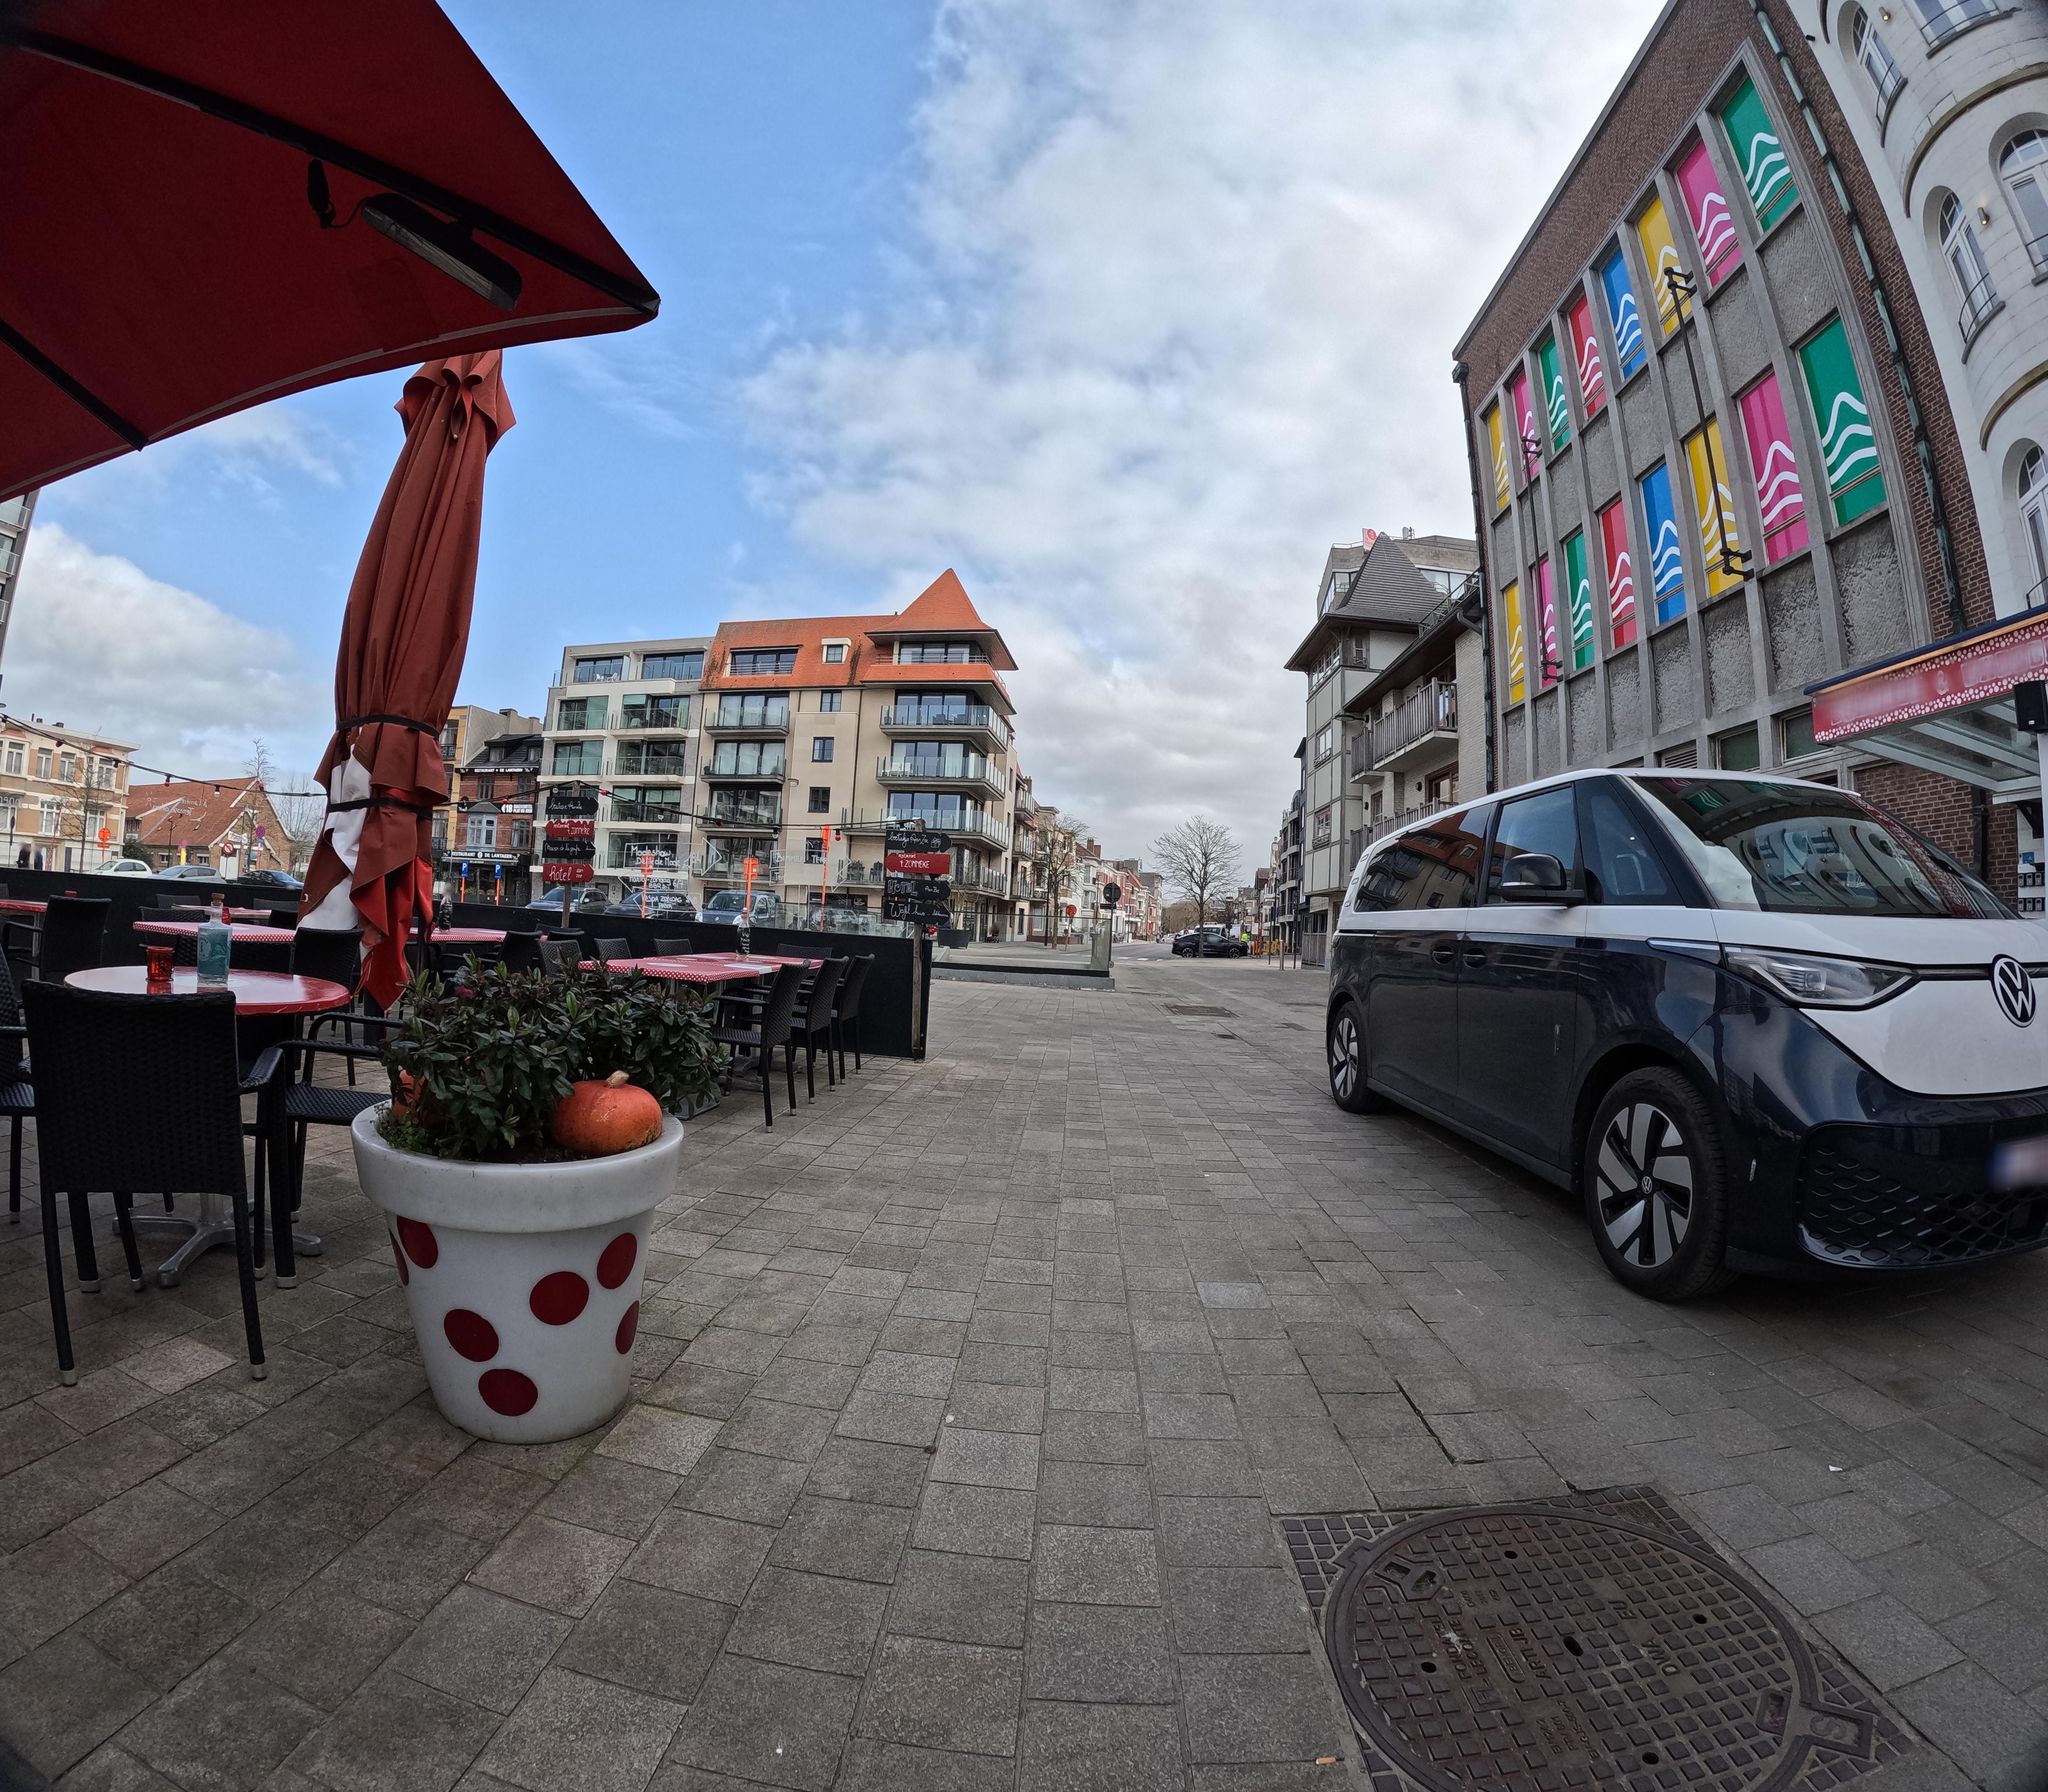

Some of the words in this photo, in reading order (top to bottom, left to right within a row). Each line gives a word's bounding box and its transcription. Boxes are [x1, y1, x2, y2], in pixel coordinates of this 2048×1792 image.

[549, 865, 572, 881] hotel
[1608, 1601, 1637, 1620] EU
[1641, 1638, 1680, 1677] DWA
